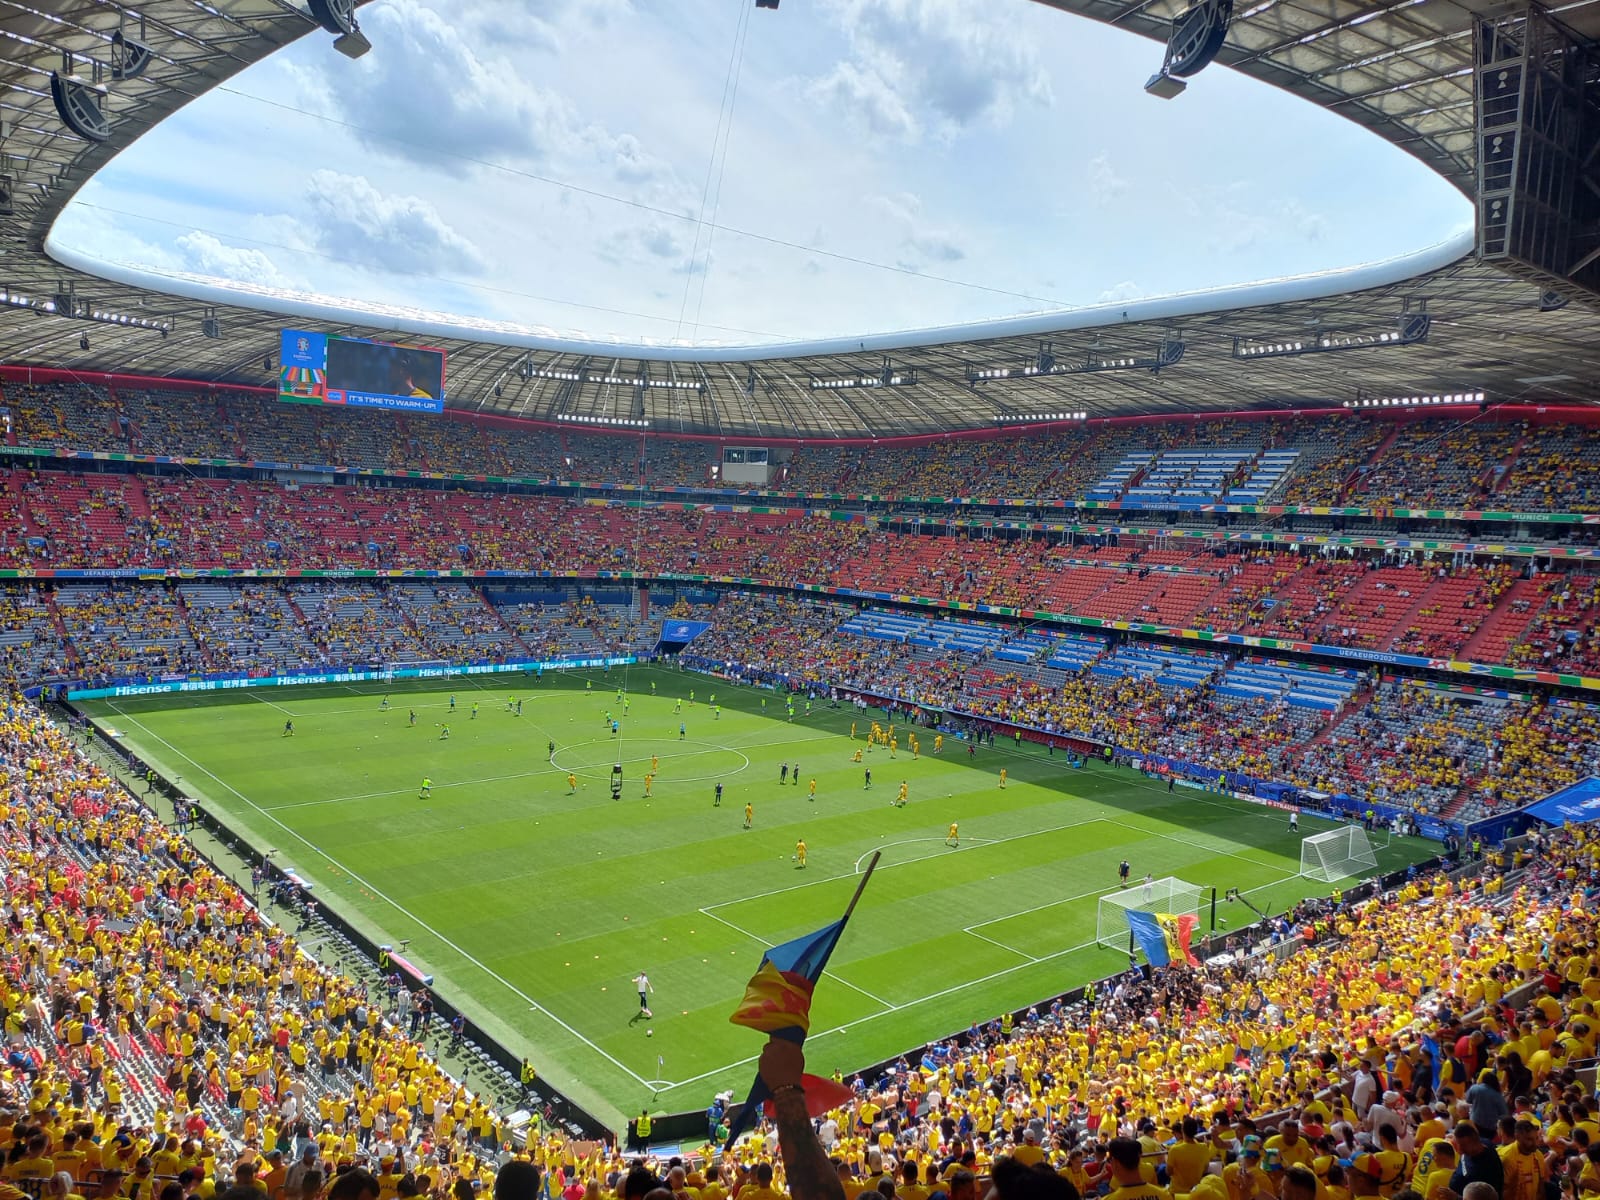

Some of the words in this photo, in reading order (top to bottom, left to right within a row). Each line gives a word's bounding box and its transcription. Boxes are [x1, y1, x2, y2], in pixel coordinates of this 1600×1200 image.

[365, 396, 383, 404] TIME
[277, 676, 327, 686] Hisense
[116, 685, 172, 696] Hisense
